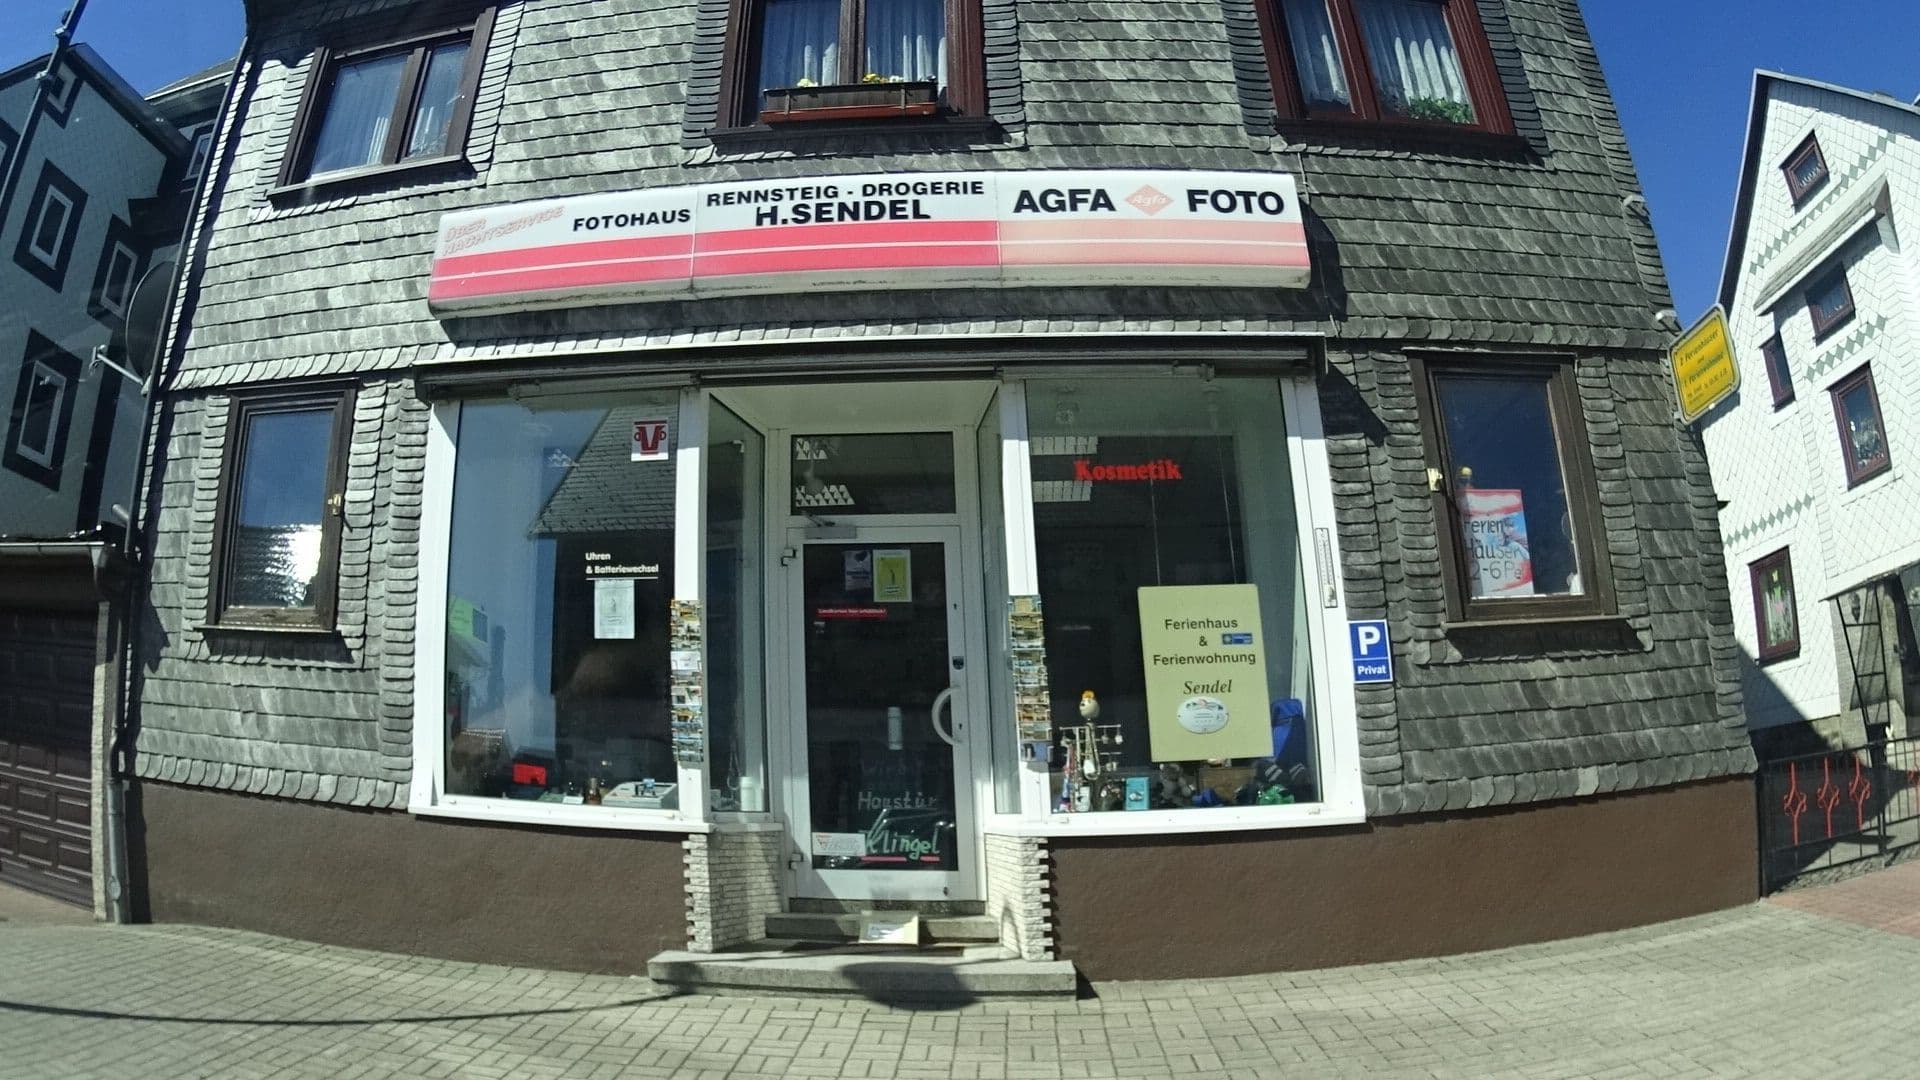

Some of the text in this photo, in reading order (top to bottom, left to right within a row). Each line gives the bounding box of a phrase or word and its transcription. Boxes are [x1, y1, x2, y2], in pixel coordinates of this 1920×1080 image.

[707, 185, 839, 207] RENNSTEIG
[862, 180, 985, 197] DROGERIE
[1013, 188, 1285, 215] AGFA FOTO
[573, 209, 691, 232] FOTOHAUS
[755, 199, 932, 227] H.SENDEL
[1074, 458, 1182, 480] Kosmetik
[585, 552, 611, 561] Uhren
[586, 564, 659, 574] & Batteriewechsel
[1165, 617, 1238, 630] Ferienhaus
[1199, 636, 1208, 646] &
[1358, 626, 1380, 655] P
[1153, 653, 1256, 666] Ferienwohnung
[1358, 665, 1387, 675] Privat
[1183, 679, 1233, 695] Sendel
